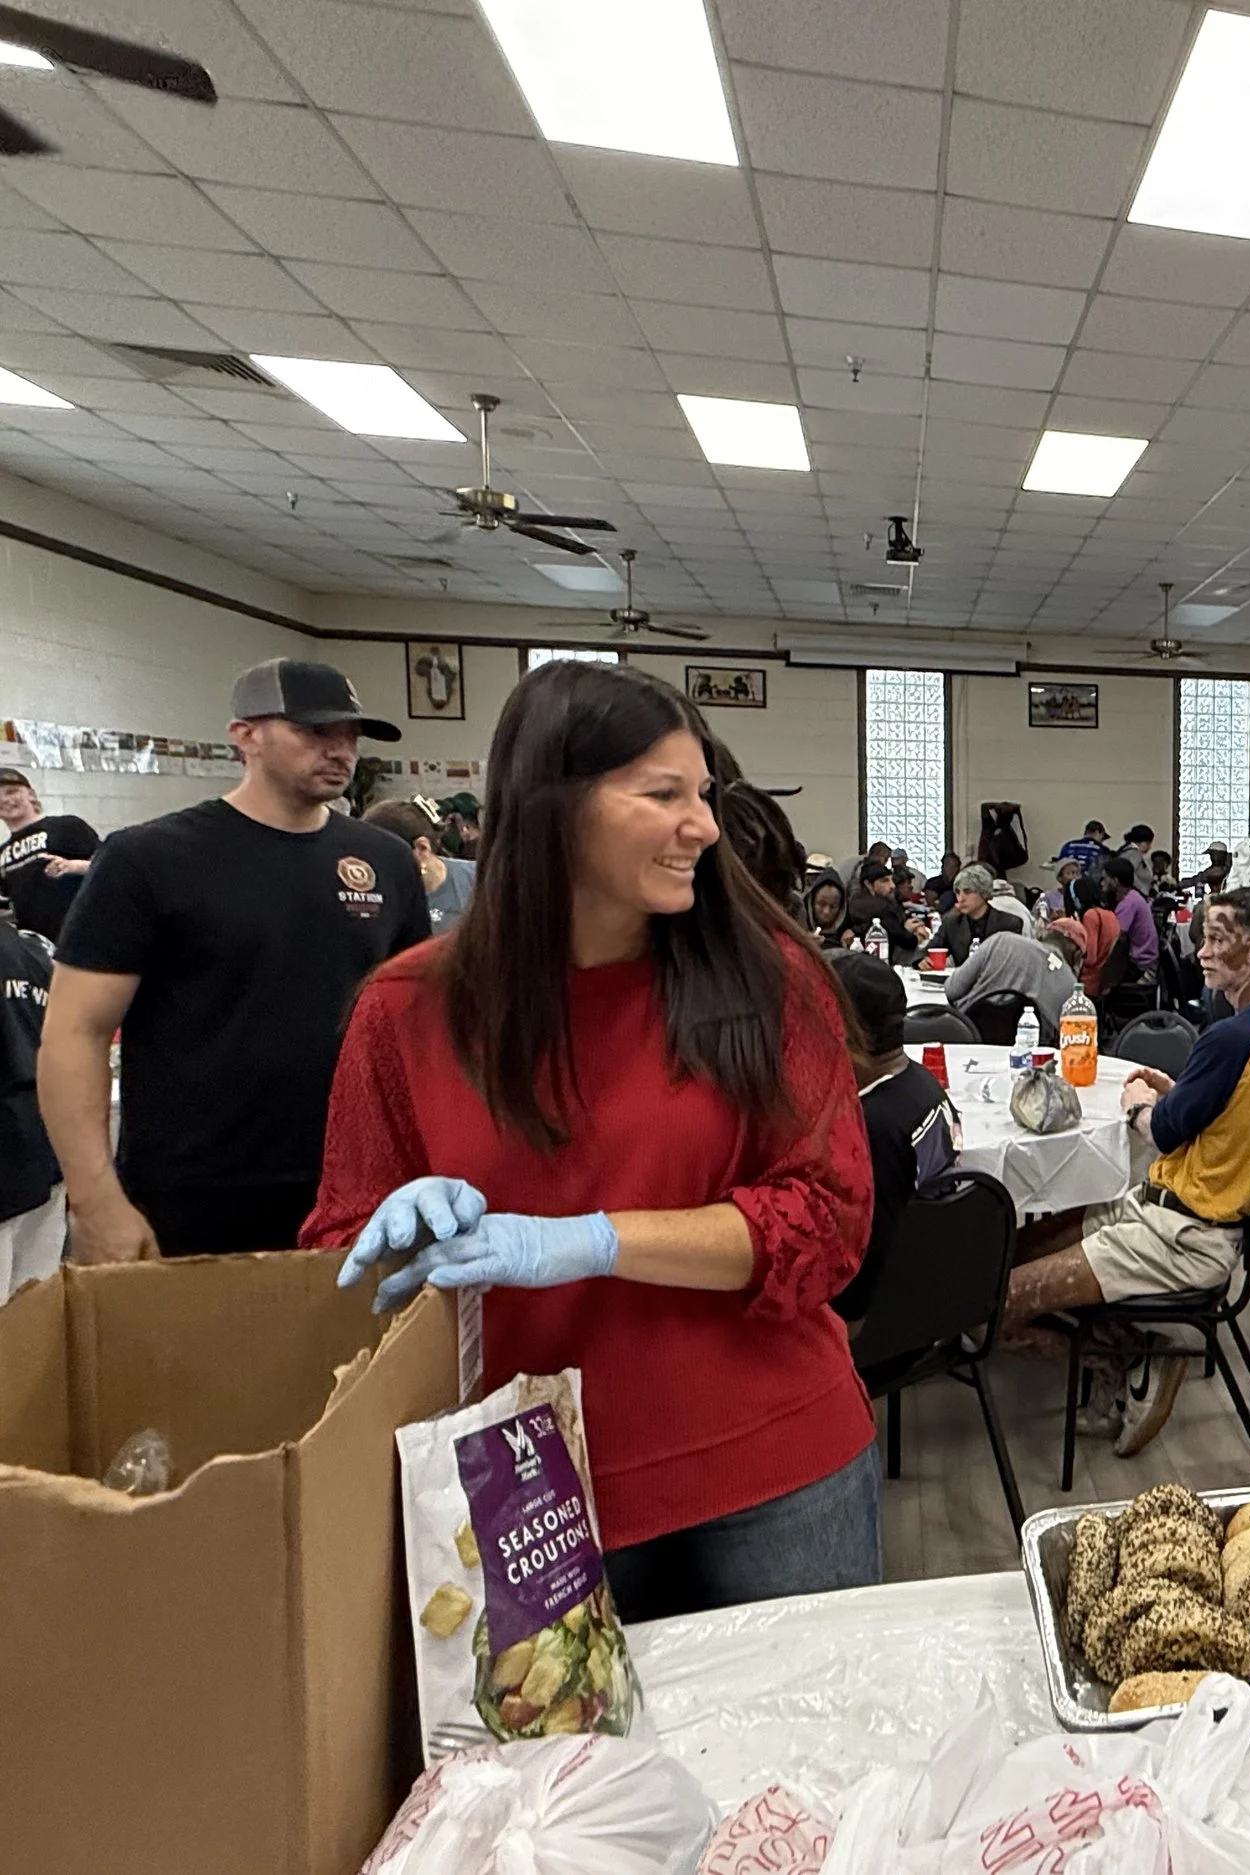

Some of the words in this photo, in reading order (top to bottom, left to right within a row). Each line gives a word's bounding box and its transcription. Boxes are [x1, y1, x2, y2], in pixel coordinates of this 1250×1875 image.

[12, 831, 48, 858] CATER
[498, 1496, 581, 1558] SEASONED
[507, 1519, 590, 1584] CROUTONS
